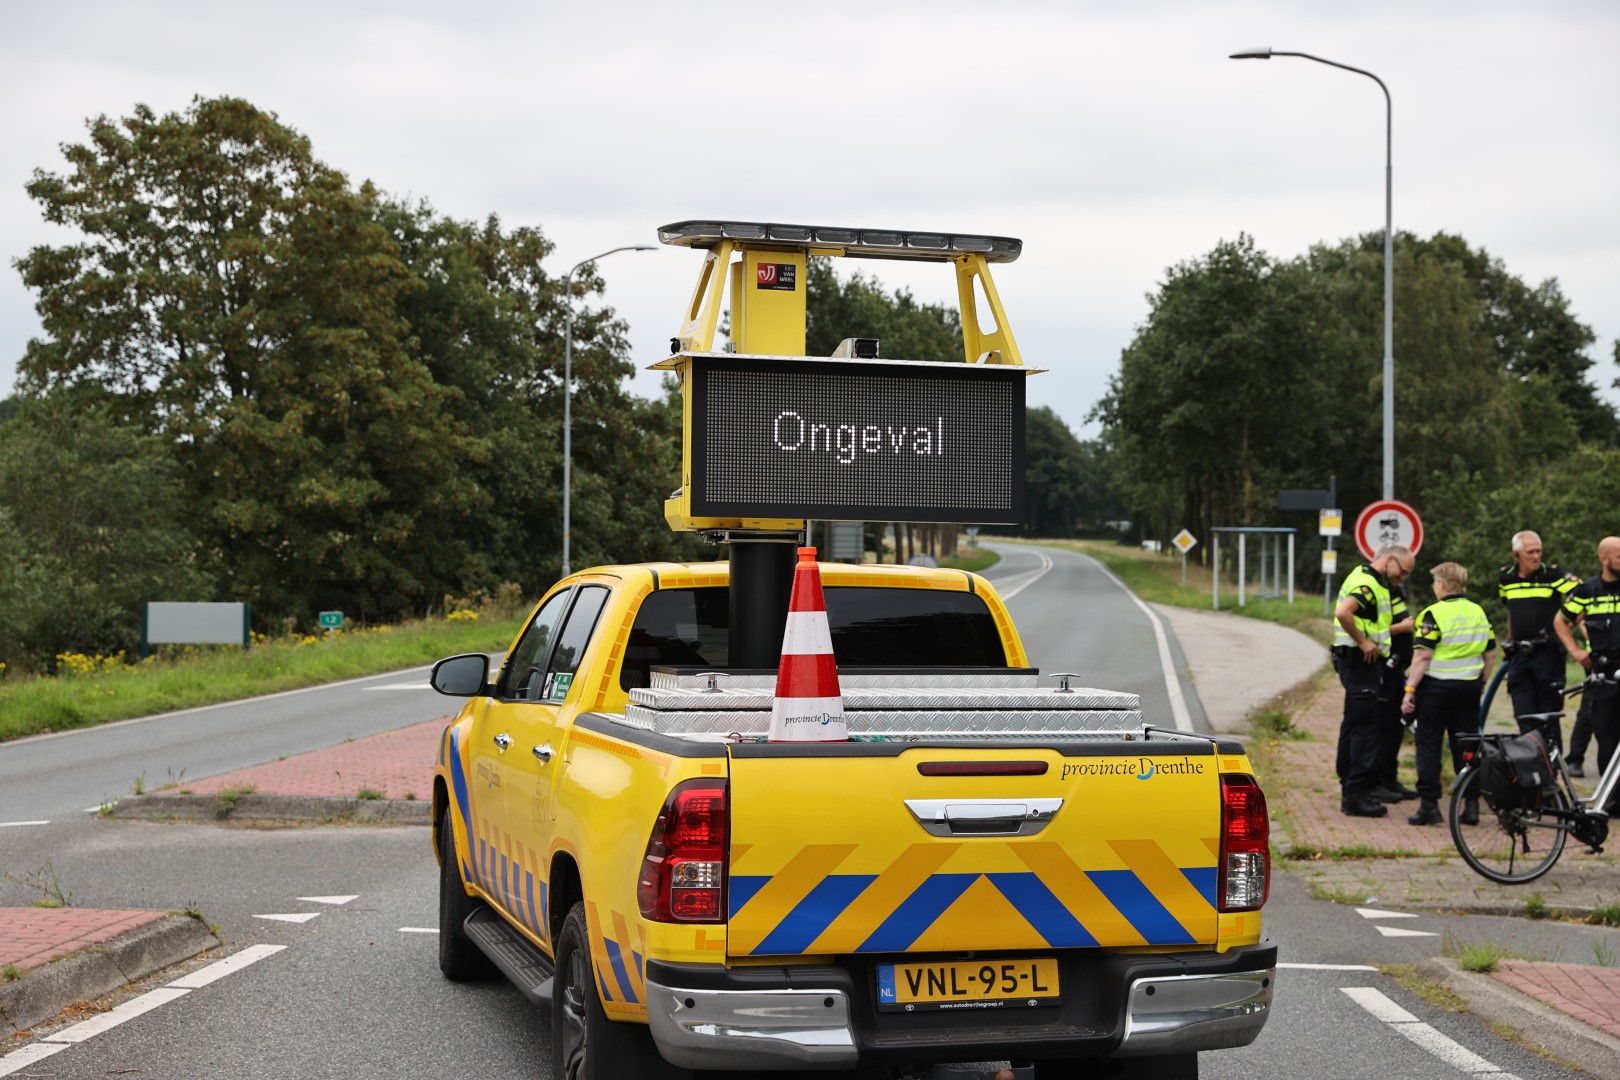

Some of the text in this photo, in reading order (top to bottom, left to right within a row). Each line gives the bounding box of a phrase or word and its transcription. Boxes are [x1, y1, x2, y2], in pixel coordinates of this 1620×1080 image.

[774, 411, 942, 464] Ongeval
[784, 714, 821, 727] provincie
[1060, 757, 1204, 781] provincie Drenthe
[904, 963, 1048, 997] VNL-95-L
[881, 988, 894, 998] NL
